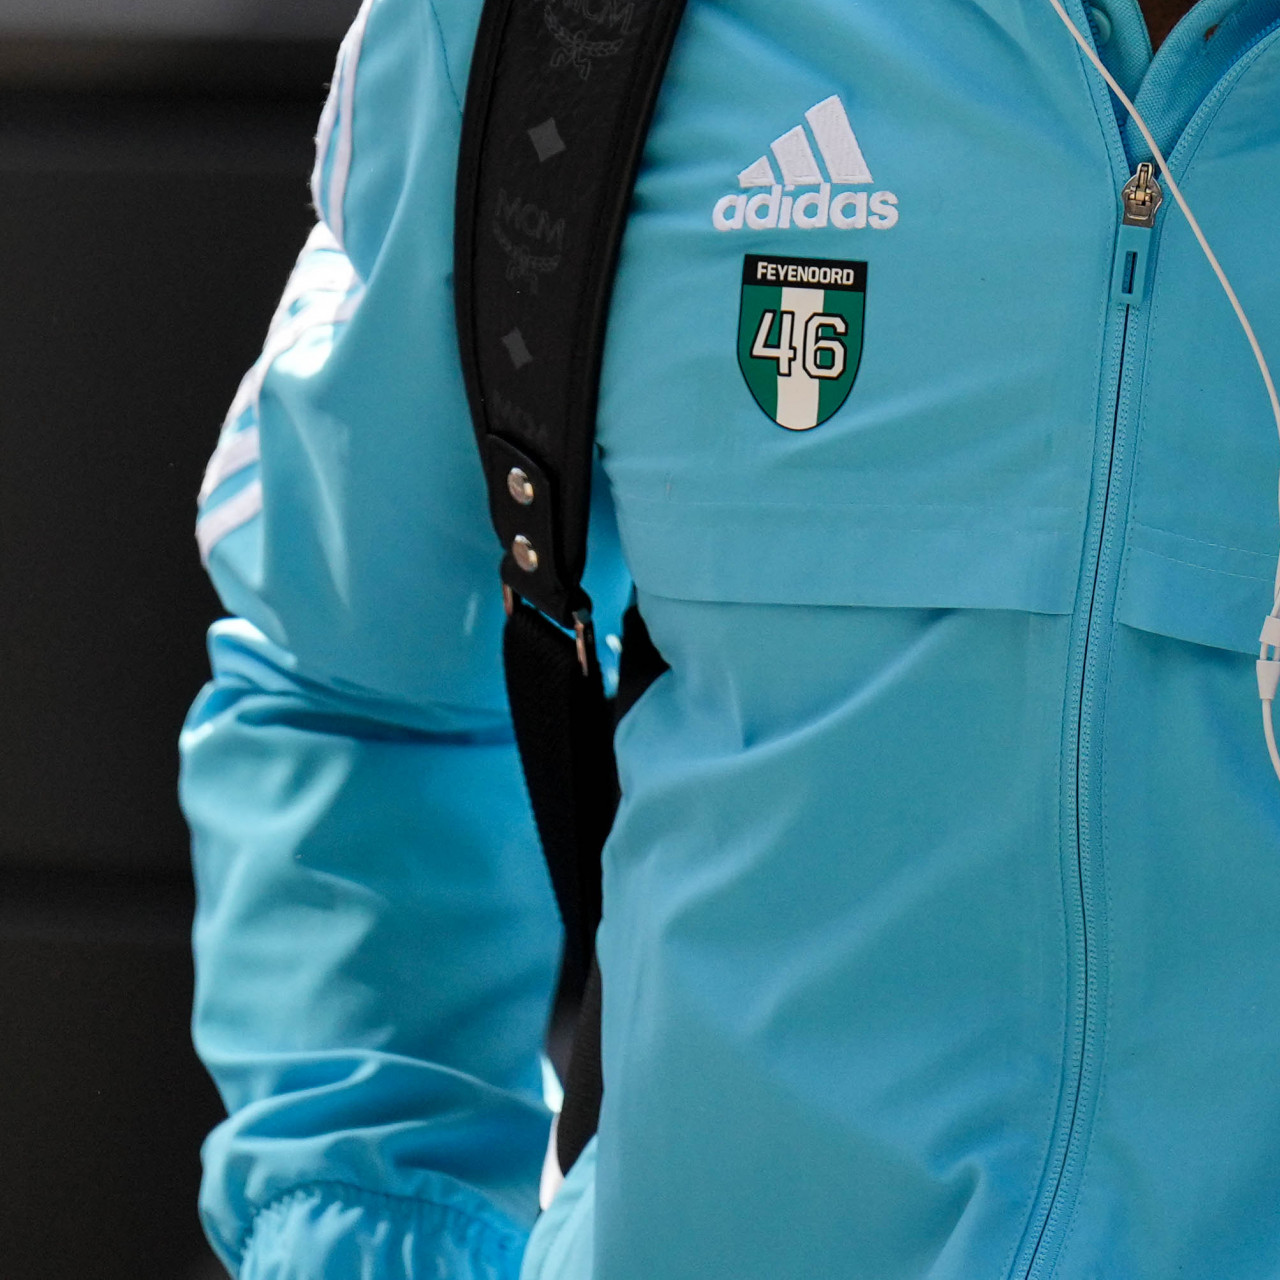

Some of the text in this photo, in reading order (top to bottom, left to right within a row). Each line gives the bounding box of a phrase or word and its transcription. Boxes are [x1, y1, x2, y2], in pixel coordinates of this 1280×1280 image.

[495, 187, 566, 252] MCM
[712, 181, 899, 232] adidas
[756, 260, 855, 286] FEYENOORD
[750, 308, 849, 380] 46
